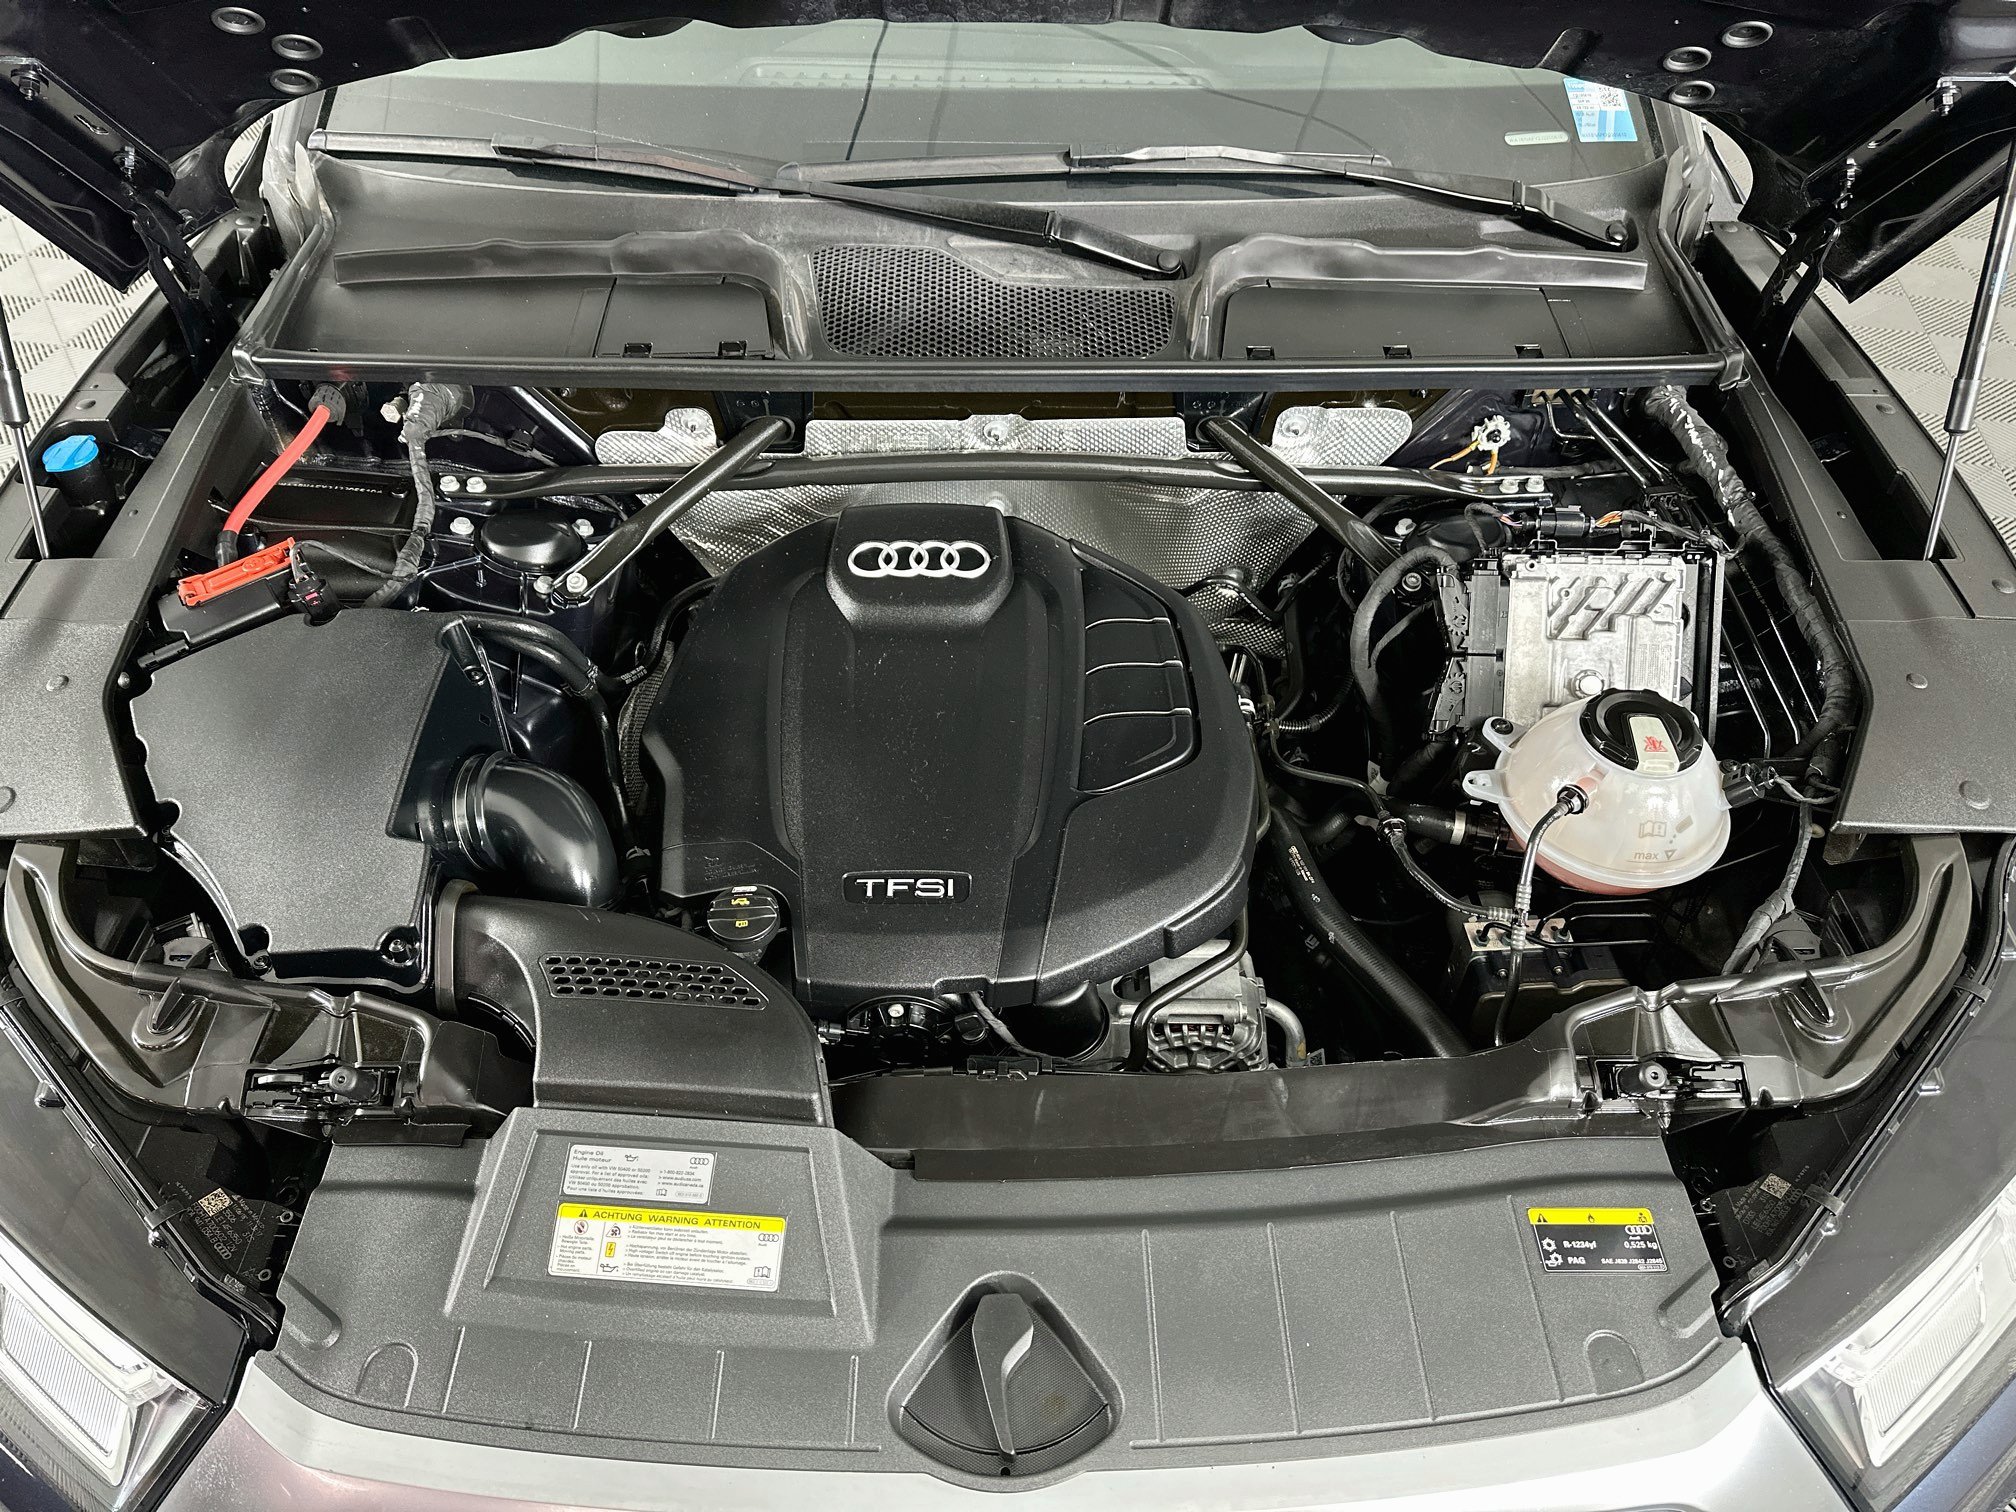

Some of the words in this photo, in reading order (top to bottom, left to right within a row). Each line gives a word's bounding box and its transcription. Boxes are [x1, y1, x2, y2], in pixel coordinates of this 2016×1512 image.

[1634, 852, 1659, 860] max
[855, 878, 954, 898] TFSI
[592, 1210, 642, 1221] ACHTUNG
[648, 1214, 699, 1225] WARNING
[704, 1218, 760, 1229] ATTENTION
[1563, 1240, 1596, 1249] R-1234yf
[1647, 1240, 1657, 1249] kg
